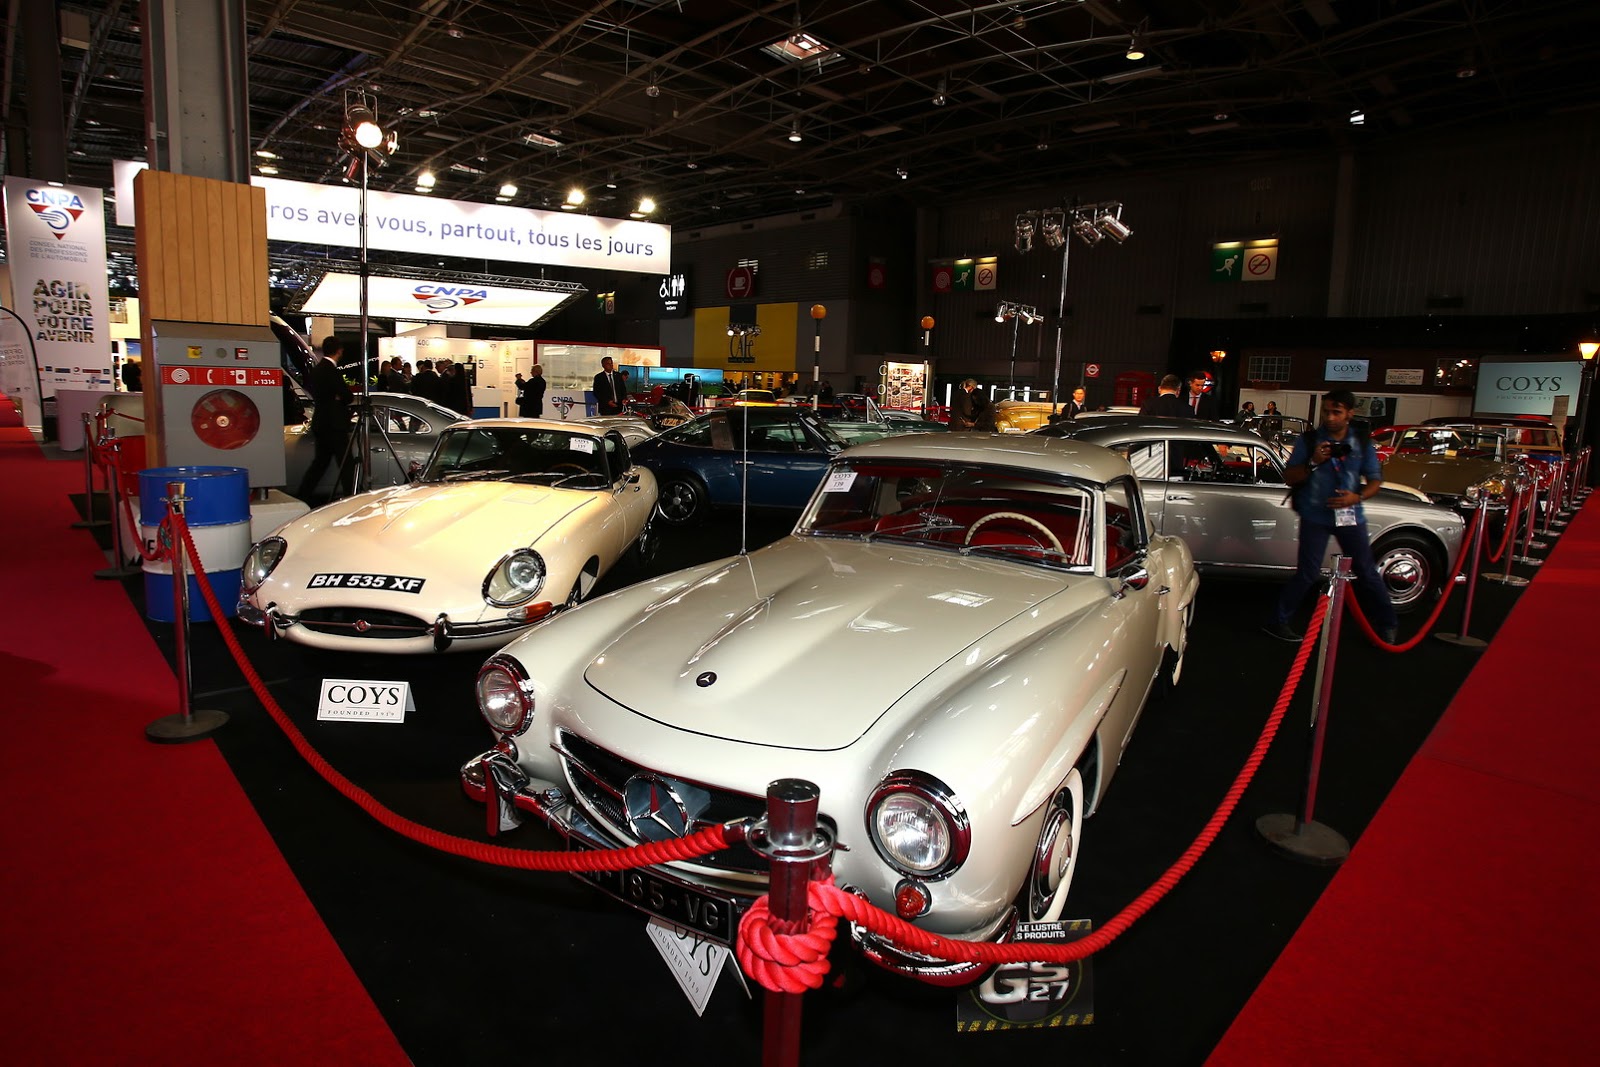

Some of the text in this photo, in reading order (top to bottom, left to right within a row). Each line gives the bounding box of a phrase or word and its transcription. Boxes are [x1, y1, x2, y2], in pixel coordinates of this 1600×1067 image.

[25, 189, 84, 209] CNPA
[376, 215, 433, 237] vous,
[441, 223, 521, 245] partout,
[528, 229, 569, 248] tous
[575, 233, 603, 251] les
[606, 236, 654, 256] jours
[33, 279, 91, 300] AGIR
[414, 285, 487, 299] CNPA
[33, 299, 93, 317] POUR
[36, 315, 94, 331] VOTRE
[36, 330, 95, 343] AVENIR
[1333, 364, 1362, 373] COYS
[1496, 376, 1562, 392] COYS
[310, 574, 422, 591] BH 535 XF
[327, 685, 400, 706] COYS
[327, 709, 371, 717] FOUNDED
[1030, 922, 1062, 932] LUSTRÉ
[1024, 930, 1066, 941] PRODUITS
